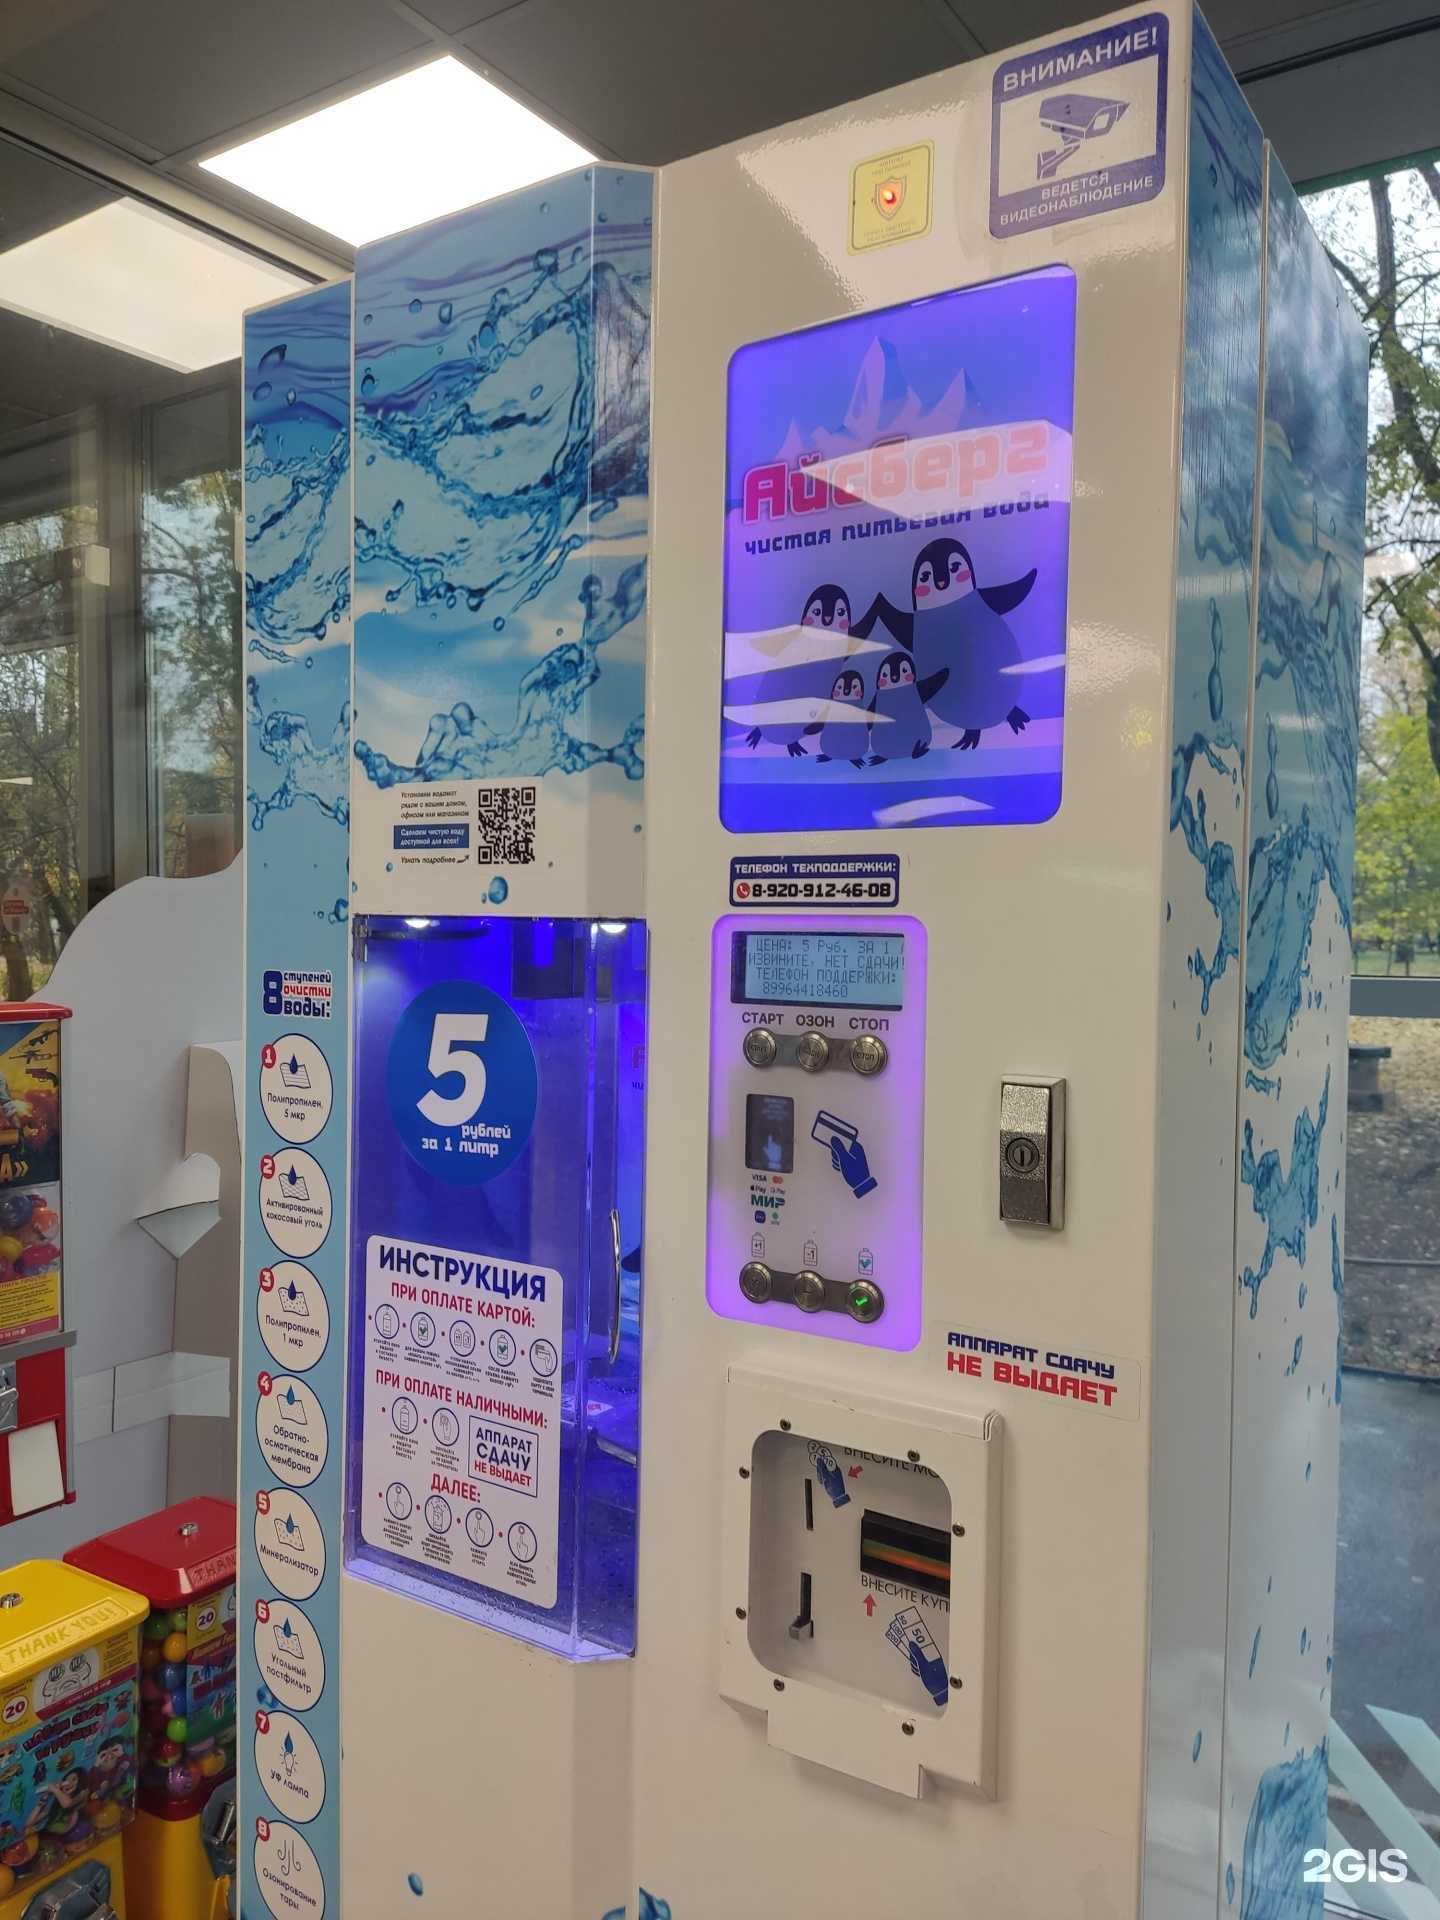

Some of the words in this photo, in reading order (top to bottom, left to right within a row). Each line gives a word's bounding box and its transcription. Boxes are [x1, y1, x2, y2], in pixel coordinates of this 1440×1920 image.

[1003, 27, 1158, 92] ВНИМАНИЕ!
[1041, 172, 1109, 200] ВЕДЕТСЯ
[1000, 176, 1153, 225] ВИДЕОНАБЛЮДЕНИЕ
[744, 422, 1048, 524] Айсберг
[745, 528, 831, 555] чистая
[735, 864, 788, 874] ТЕЛЕФОН
[792, 862, 896, 873] ТЕХПОДДЕРЖКИ:
[752, 882, 891, 898] 8-920-912-46-08
[756, 939, 792, 952] ЦЕНА:
[802, 939, 810, 952] 5
[858, 941, 874, 954] ЗА
[825, 955, 849, 969] НЕТ
[284, 971, 331, 984] ступеней
[756, 967, 809, 981] ТЕЛЕФОН
[817, 969, 896, 985] ПОДДЕРЖКИ:
[264, 971, 282, 1015] 8
[284, 985, 331, 998] очистки
[284, 998, 331, 1018] воды:
[742, 1012, 784, 1026] СТАРТ
[796, 1014, 835, 1028] ОЗОН
[849, 1017, 889, 1031] СТОП
[265, 1048, 273, 1065] 1
[416, 1013, 489, 1127] 5
[284, 1109, 289, 1119] 5
[290, 1110, 306, 1121] мкр
[462, 1123, 511, 1139] рублей
[422, 1138, 438, 1150] за
[444, 1138, 453, 1151] 1
[459, 1140, 499, 1158] литр
[262, 1160, 273, 1175] 2
[266, 1197, 323, 1217] Активированный
[751, 1194, 786, 1209] МИР
[266, 1210, 303, 1226] кокосовый
[304, 1218, 323, 1230] уголь
[262, 1271, 271, 1289] 3
[379, 1244, 546, 1303] ИНСТРУКЦИЯ
[391, 1282, 417, 1301] ПРИ
[422, 1289, 473, 1314] ОПЛАТЕ
[477, 1300, 536, 1328] КАРТОЙ:
[288, 1336, 304, 1348] мкр
[947, 1331, 1038, 1363] АППАРАТ
[1045, 1353, 1115, 1379] СДАЧУ
[260, 1375, 270, 1391] 4
[947, 1351, 982, 1377] НЕ
[993, 1363, 1118, 1407] ВЫДАЕТ
[375, 1369, 400, 1389] ПРИ
[404, 1377, 452, 1403] ОПЛАТЕ
[456, 1391, 549, 1430] НАЛИЧНЫМИ:
[273, 1424, 310, 1445] Обратно-
[476, 1426, 533, 1454] АППАРАТ
[264, 1437, 319, 1463] осмотическая
[476, 1442, 531, 1472] СДАЧУ
[270, 1454, 312, 1475] мембрана
[474, 1460, 488, 1474] НЕ
[489, 1464, 532, 1488] ВЫДАЕТ
[430, 1472, 481, 1504] ДАЛЕЕ:
[259, 1494, 268, 1510] 5
[260, 1544, 319, 1577] Минерализатор
[861, 1574, 918, 1603] ВНЕСИТЕ
[921, 1593, 950, 1613] КУП
[198, 1612, 214, 1627] 20
[259, 1603, 267, 1620] 6
[898, 1615, 908, 1626] 50
[6, 1626, 71, 1662] THANK
[71, 1606, 118, 1631] YOU!
[911, 1628, 926, 1644] 50
[271, 1653, 307, 1678] Угольный
[266, 1664, 312, 1695] постфильтр
[5, 1701, 26, 1719] 20
[257, 1714, 267, 1731] 7
[283, 1778, 310, 1800] лампа
[262, 1866, 318, 1907] Озонирование
[280, 1892, 300, 1910] тары
